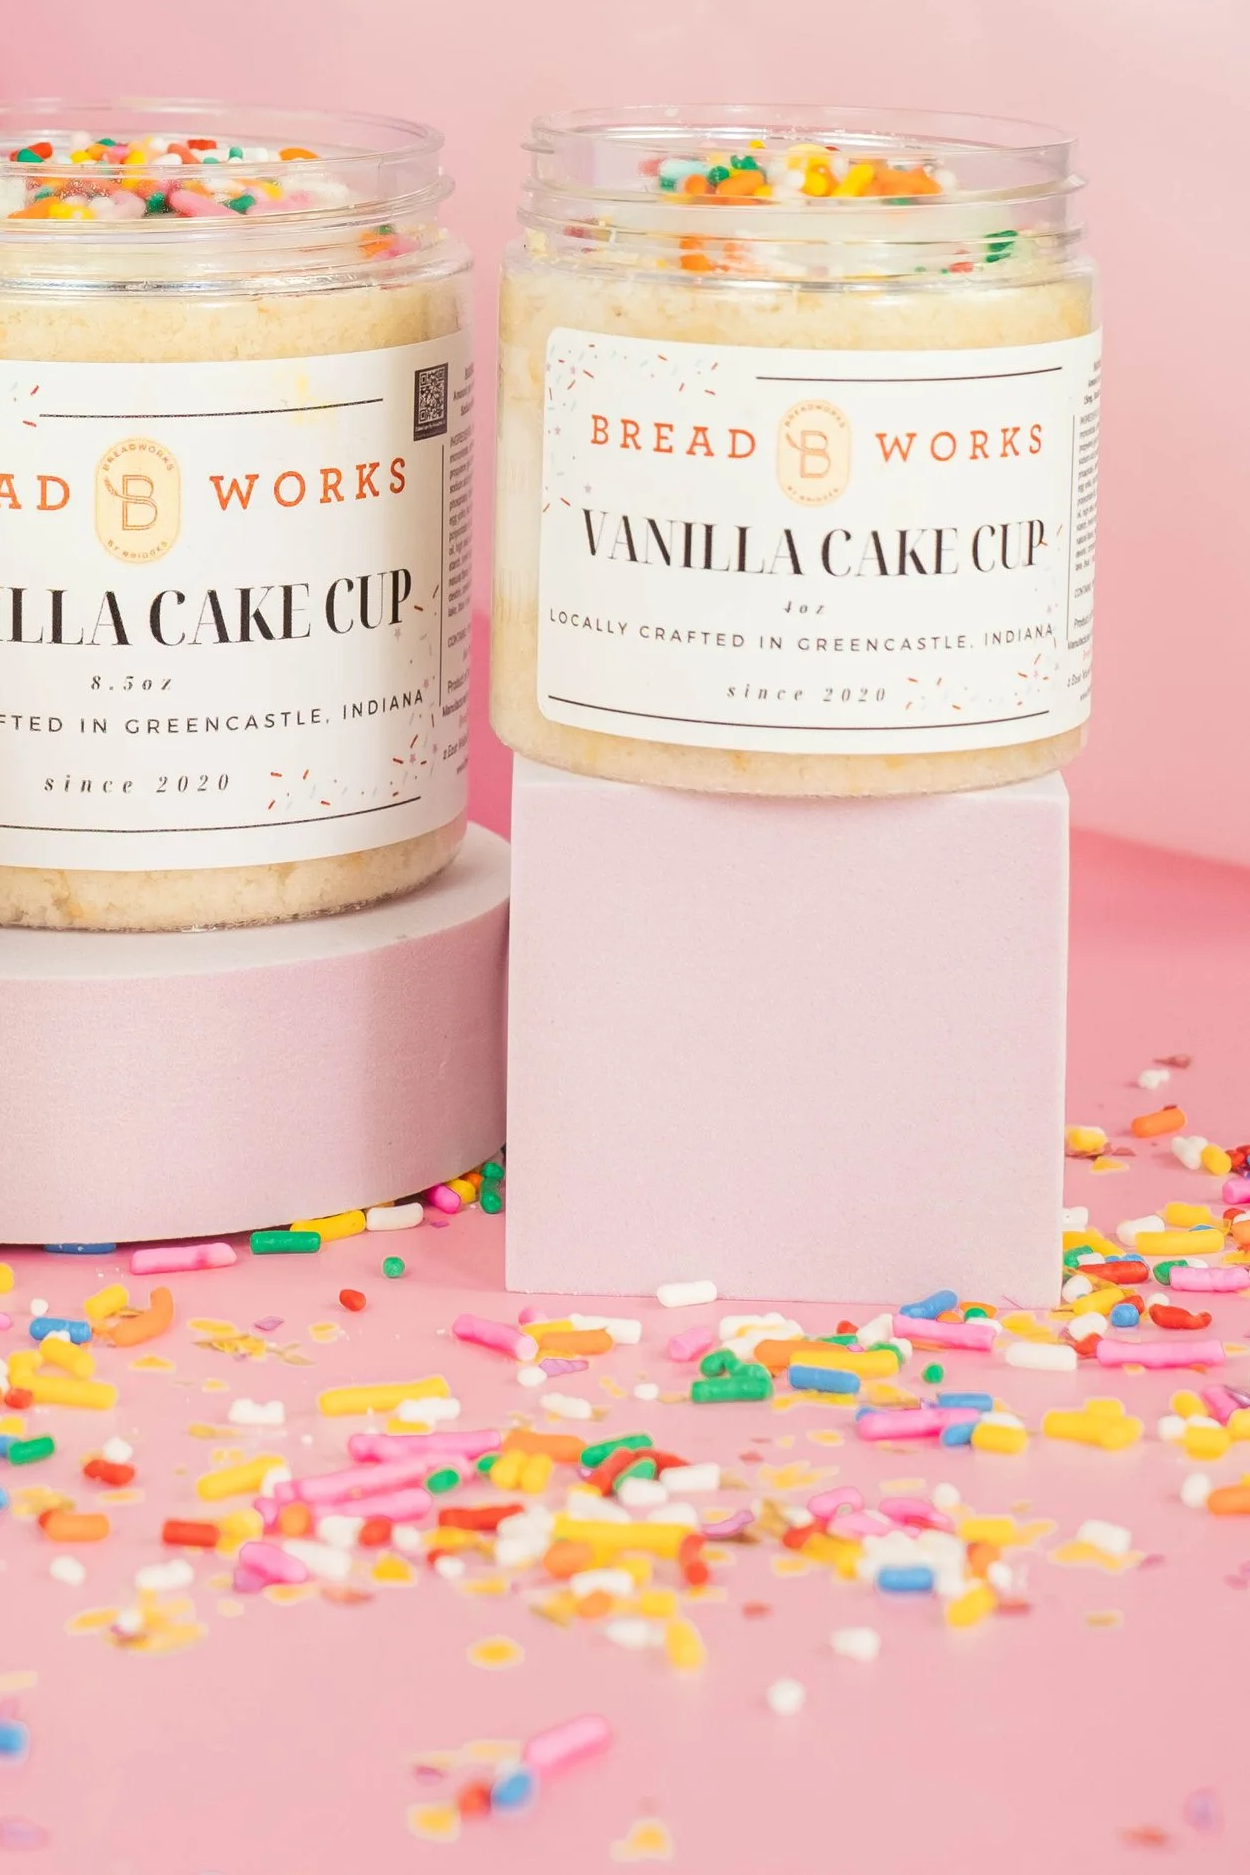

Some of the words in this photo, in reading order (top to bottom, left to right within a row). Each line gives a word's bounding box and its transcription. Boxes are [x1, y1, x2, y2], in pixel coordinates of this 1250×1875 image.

[590, 413, 757, 460] BREAD
[875, 424, 1044, 464] WORKS
[786, 430, 831, 478] B
[104, 474, 159, 532] B
[209, 456, 407, 512] WORKS
[581, 507, 804, 577] VANILLA
[819, 525, 960, 578] CAKE
[970, 518, 1047, 574] CUP
[148, 582, 313, 647] CAKE
[324, 567, 412, 636] CUP
[550, 608, 628, 635] LOCALLY
[639, 625, 745, 648] CRAFTED
[760, 636, 782, 649] IN
[985, 623, 1053, 646] INDIANA
[91, 675, 171, 691] 8.5oz
[727, 683, 803, 701] since
[823, 687, 885, 703] 2020
[81, 718, 107, 733] IN
[125, 708, 330, 734] GREENCASTLE,
[343, 689, 423, 720] INDIANA
[44, 774, 133, 794] since
[156, 774, 229, 793] 2020
